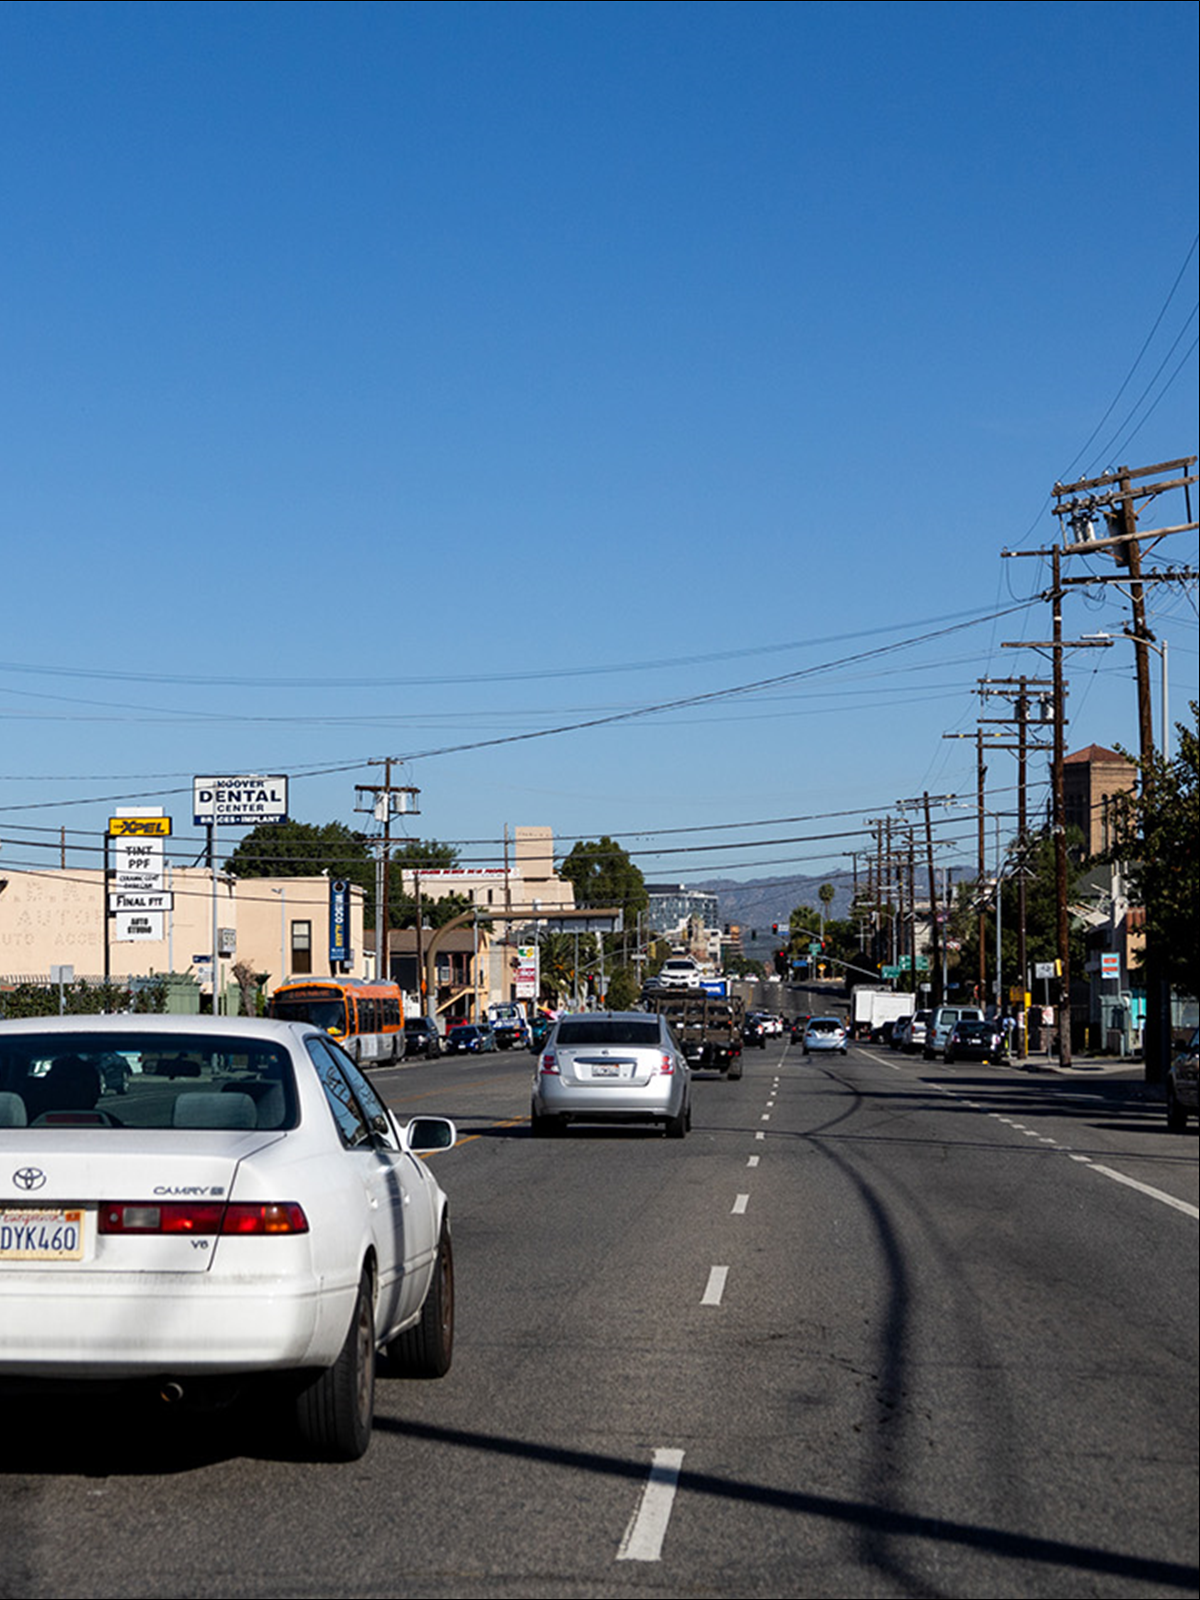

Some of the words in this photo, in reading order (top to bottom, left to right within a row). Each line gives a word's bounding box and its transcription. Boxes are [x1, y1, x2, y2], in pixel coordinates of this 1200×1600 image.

[199, 790, 282, 803] DENTAL
[216, 804, 264, 812] CENTER
[121, 821, 165, 833] XPEL
[125, 846, 153, 856] TINT
[128, 859, 150, 868] PPF
[116, 894, 146, 907] FINAL
[153, 1186, 209, 1195] CAMRY
[191, 1240, 209, 1249] V6
